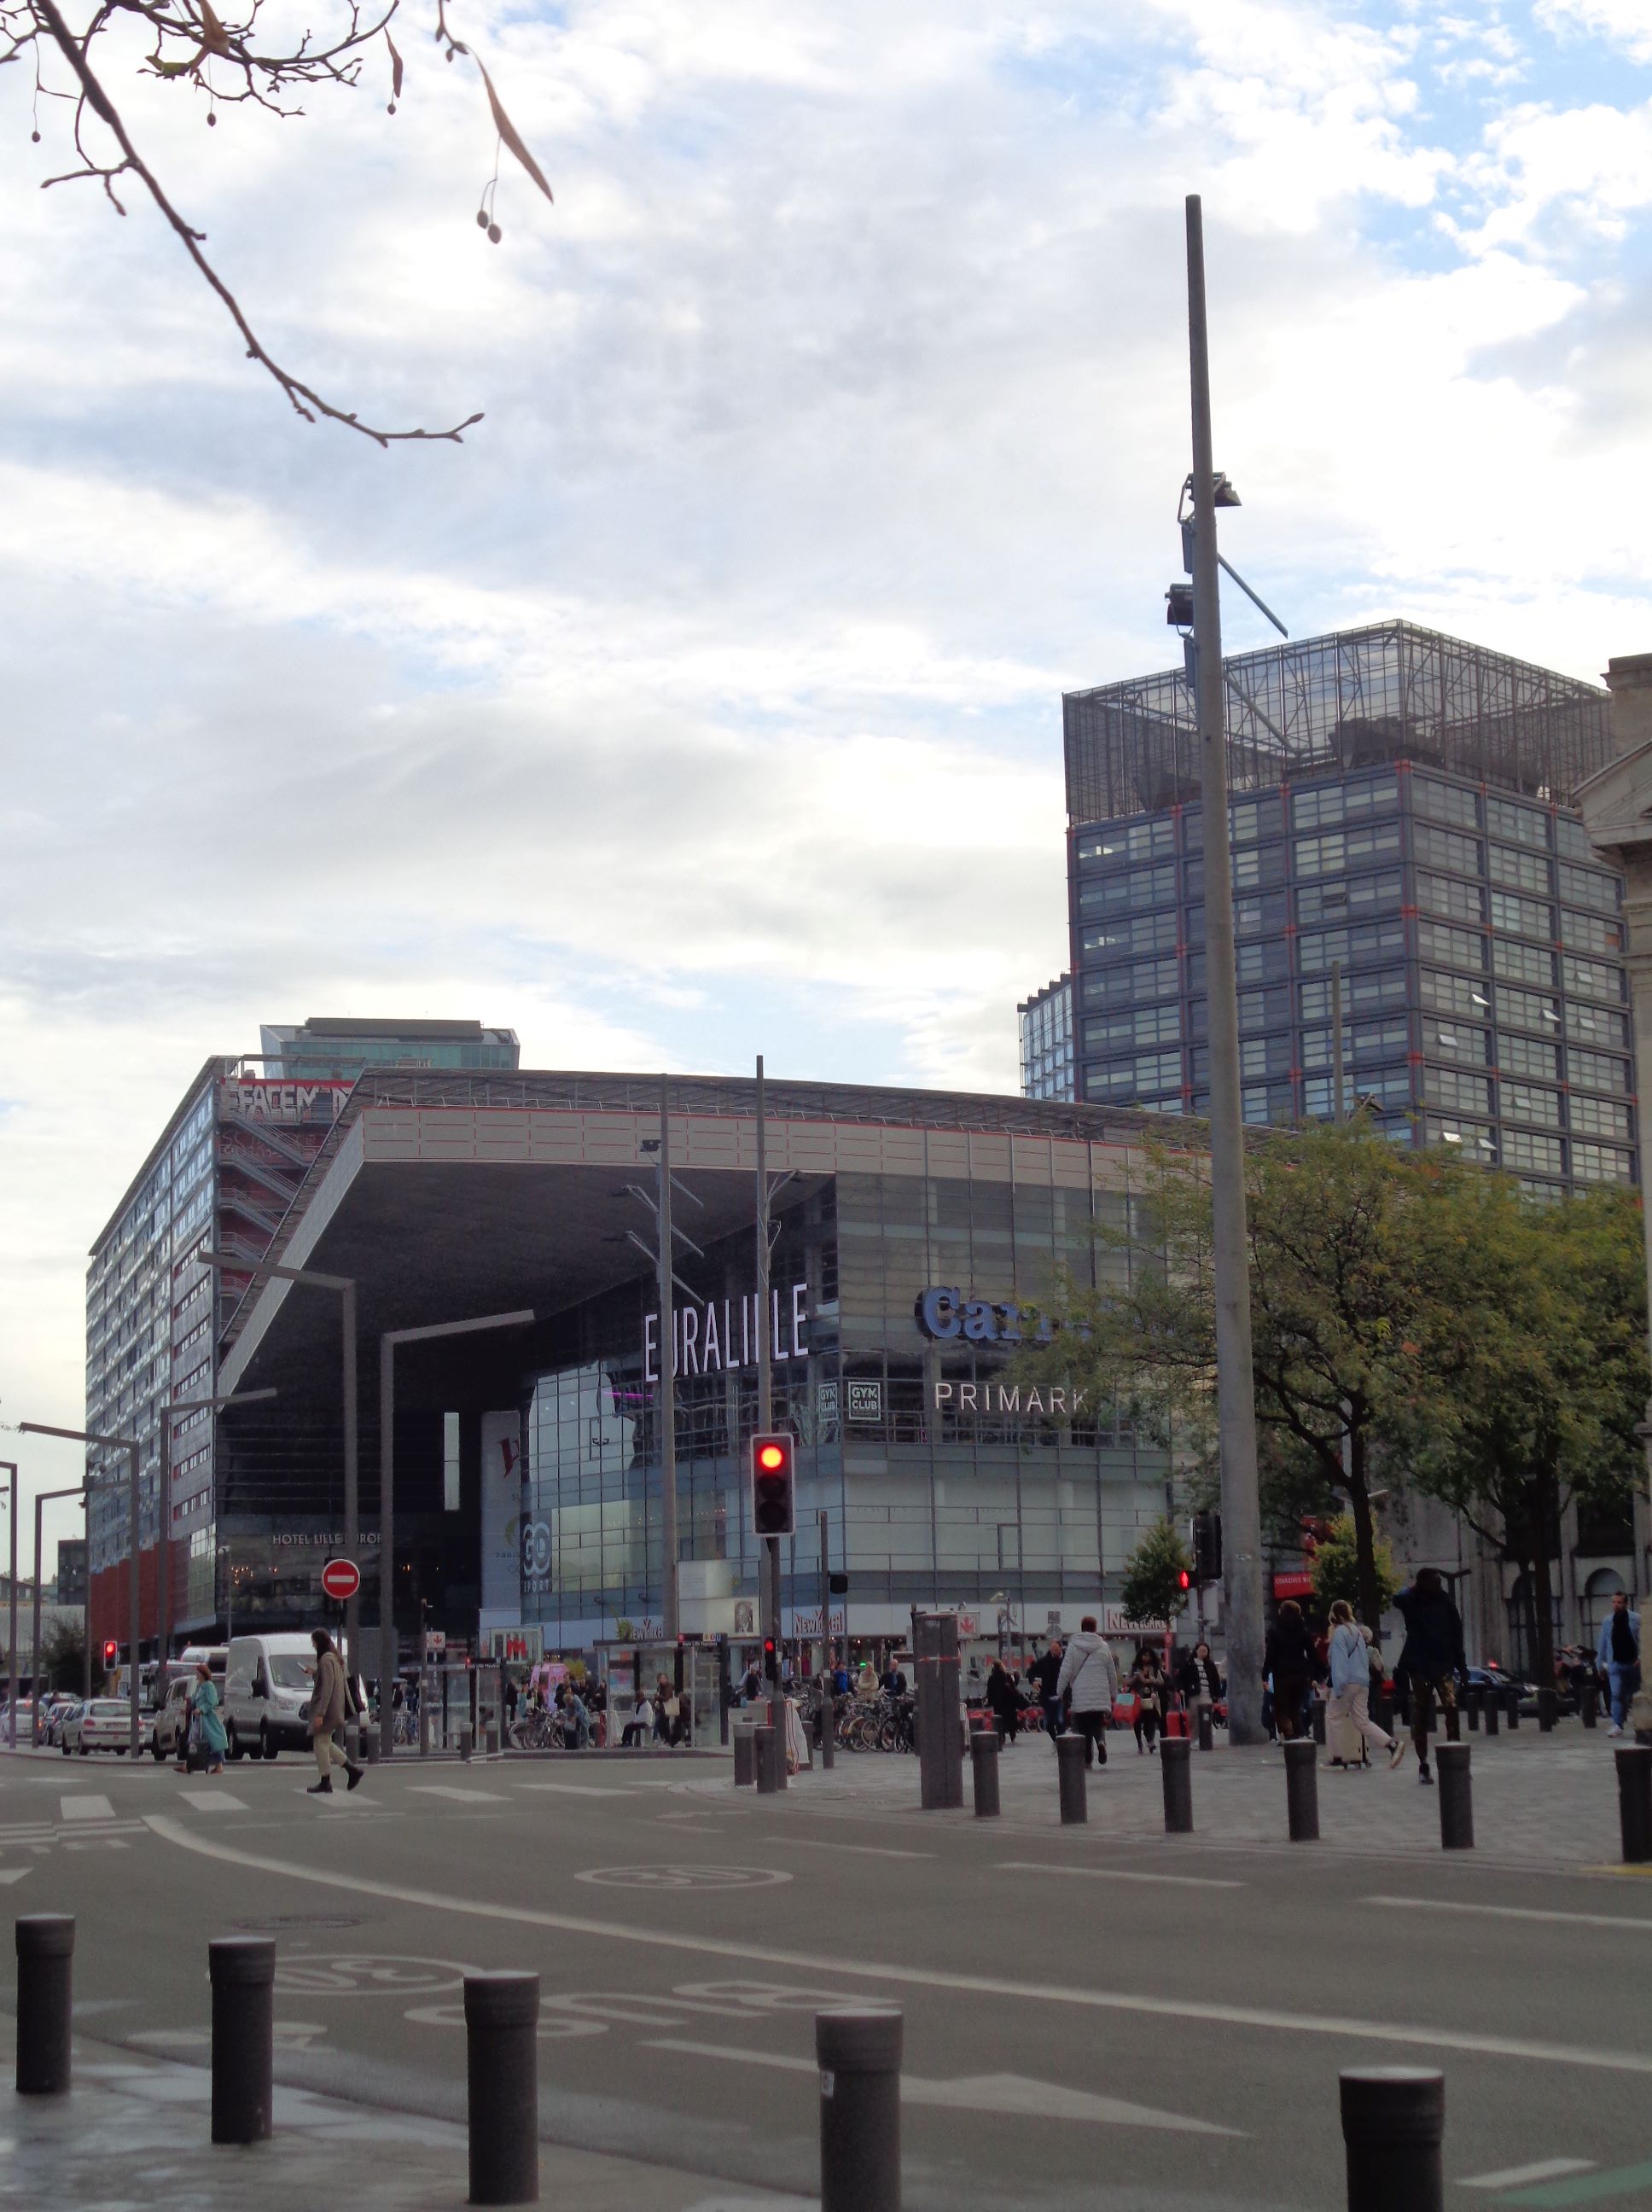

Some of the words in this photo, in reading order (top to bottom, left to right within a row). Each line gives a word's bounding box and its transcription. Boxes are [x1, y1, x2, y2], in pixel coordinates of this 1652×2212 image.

[934, 1382, 1089, 1413] PRIMARK
[852, 1400, 877, 1410] CLUB
[273, 1534, 310, 1545] HOTEL
[313, 1534, 340, 1544] LILLE
